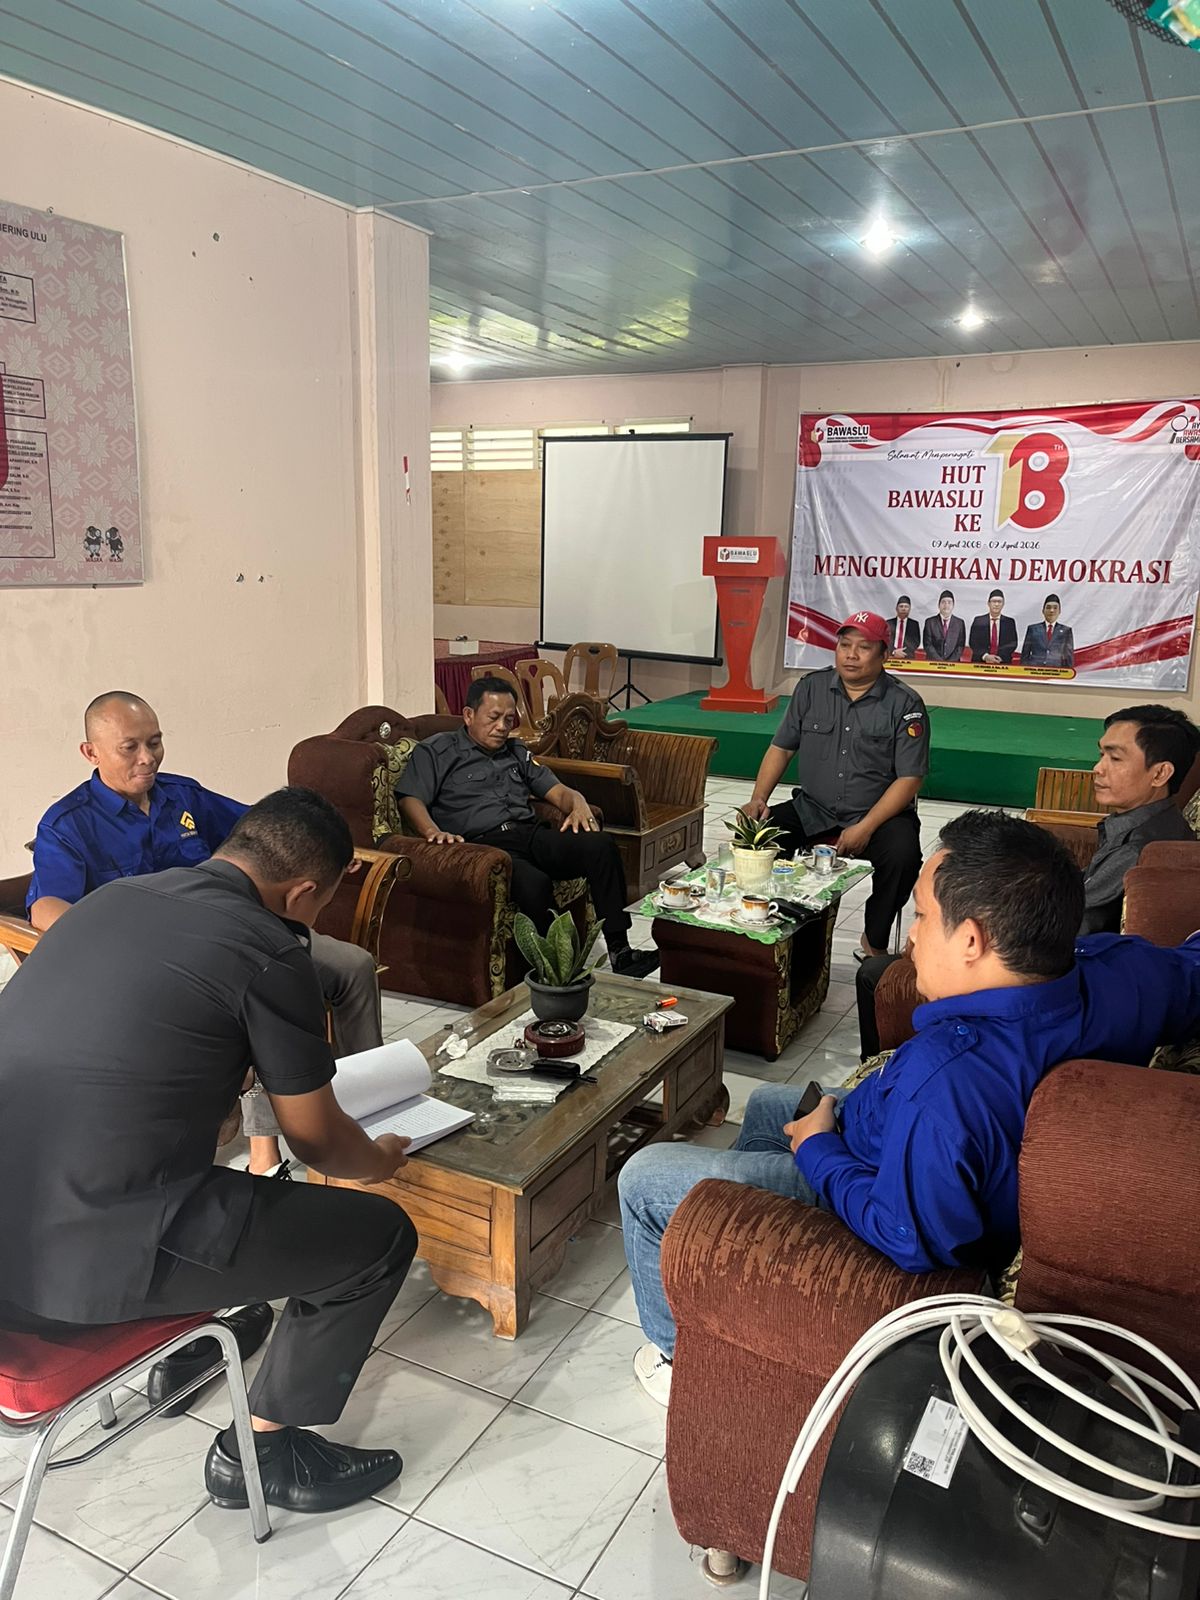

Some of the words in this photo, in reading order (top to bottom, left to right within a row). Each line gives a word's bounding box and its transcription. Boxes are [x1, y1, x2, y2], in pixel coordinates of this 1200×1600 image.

[30, 230, 47, 243] ULU
[827, 426, 869, 436] BAWASLU
[887, 449, 920, 461] Selamat
[921, 449, 976, 461] Memperingati
[941, 465, 986, 484] HUT
[984, 432, 1069, 529] 18
[887, 490, 984, 508] BAWASLU
[954, 514, 982, 532] KE
[813, 555, 1002, 581] MENGUKUHKAN
[1008, 558, 1173, 584] DEMOKRASI
[854, 612, 869, 623] NY
